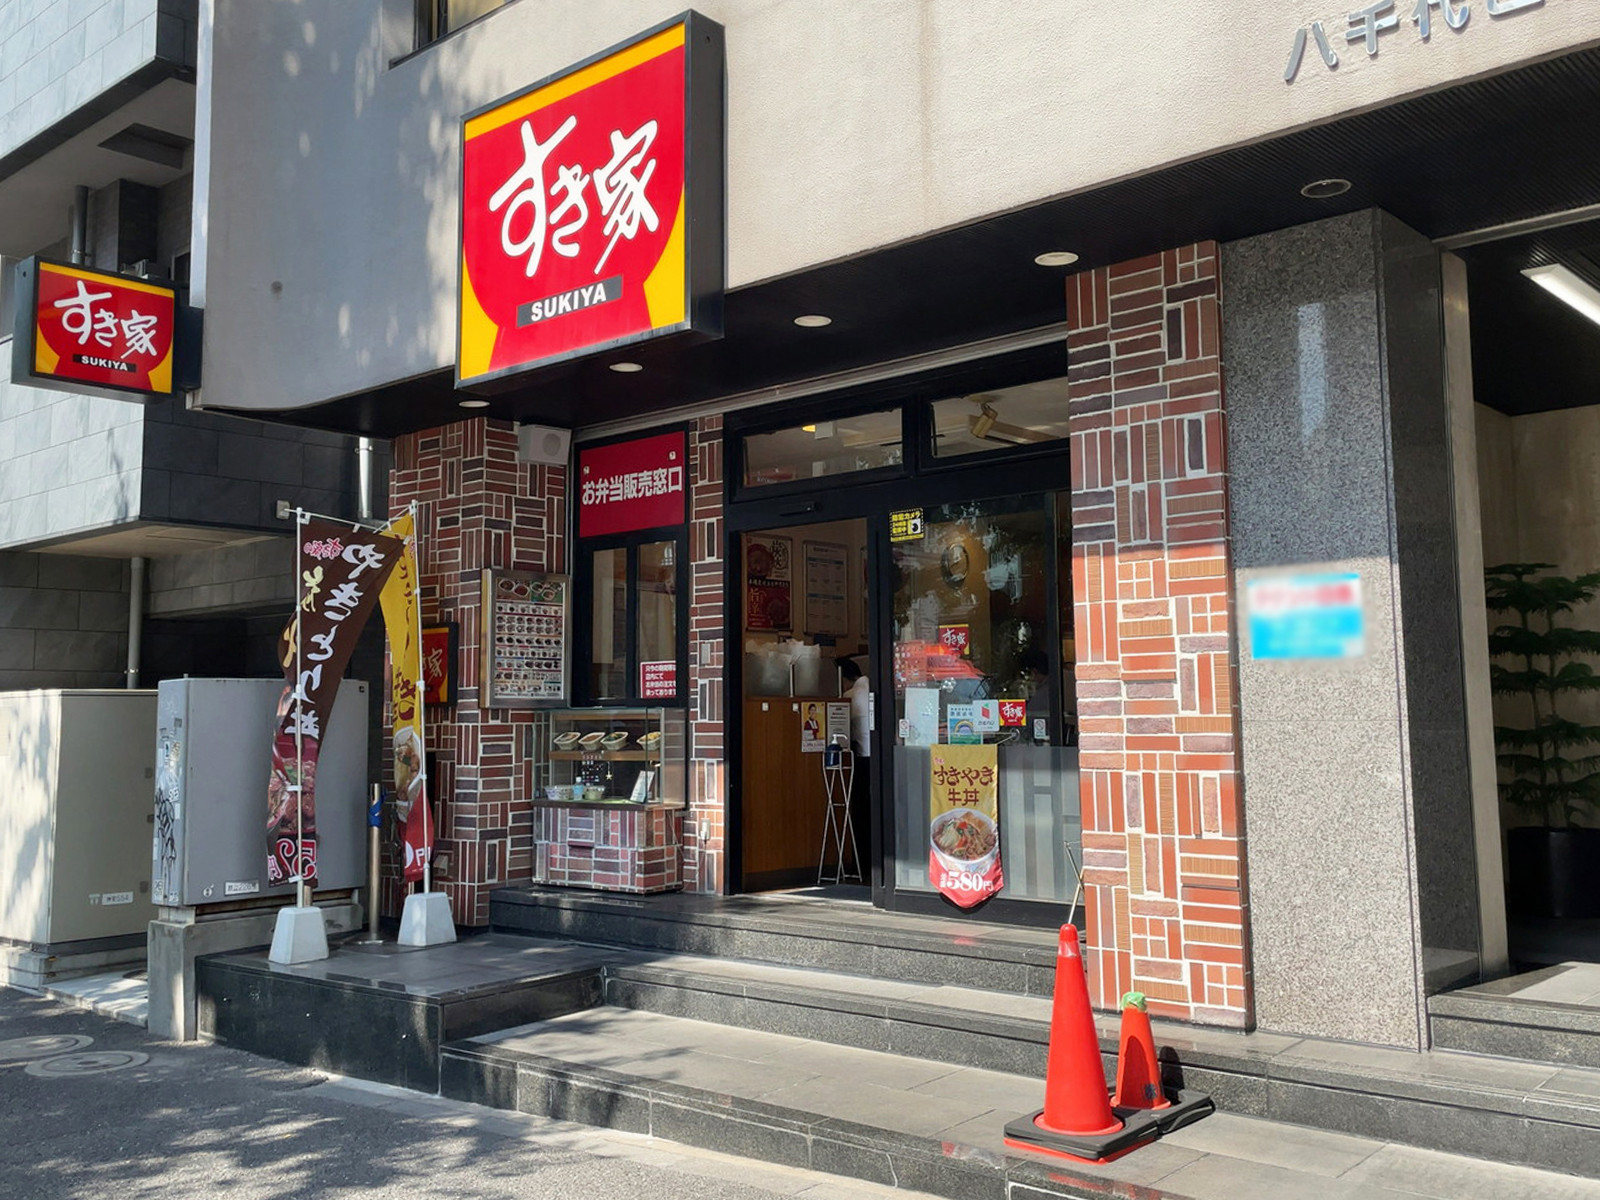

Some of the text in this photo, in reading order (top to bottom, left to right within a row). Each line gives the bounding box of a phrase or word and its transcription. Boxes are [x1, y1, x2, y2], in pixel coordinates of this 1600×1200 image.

[1284, 0, 1544, 81] 八千代
[488, 115, 660, 278] すき家
[53, 280, 158, 359] すき家
[530, 282, 608, 322] SUKIYA
[81, 355, 129, 371] SUKIYA
[581, 465, 683, 506] お弁当販売窓口
[1002, 702, 1023, 719] すき家
[933, 765, 994, 787] すきやき
[948, 788, 980, 806] 牛丼
